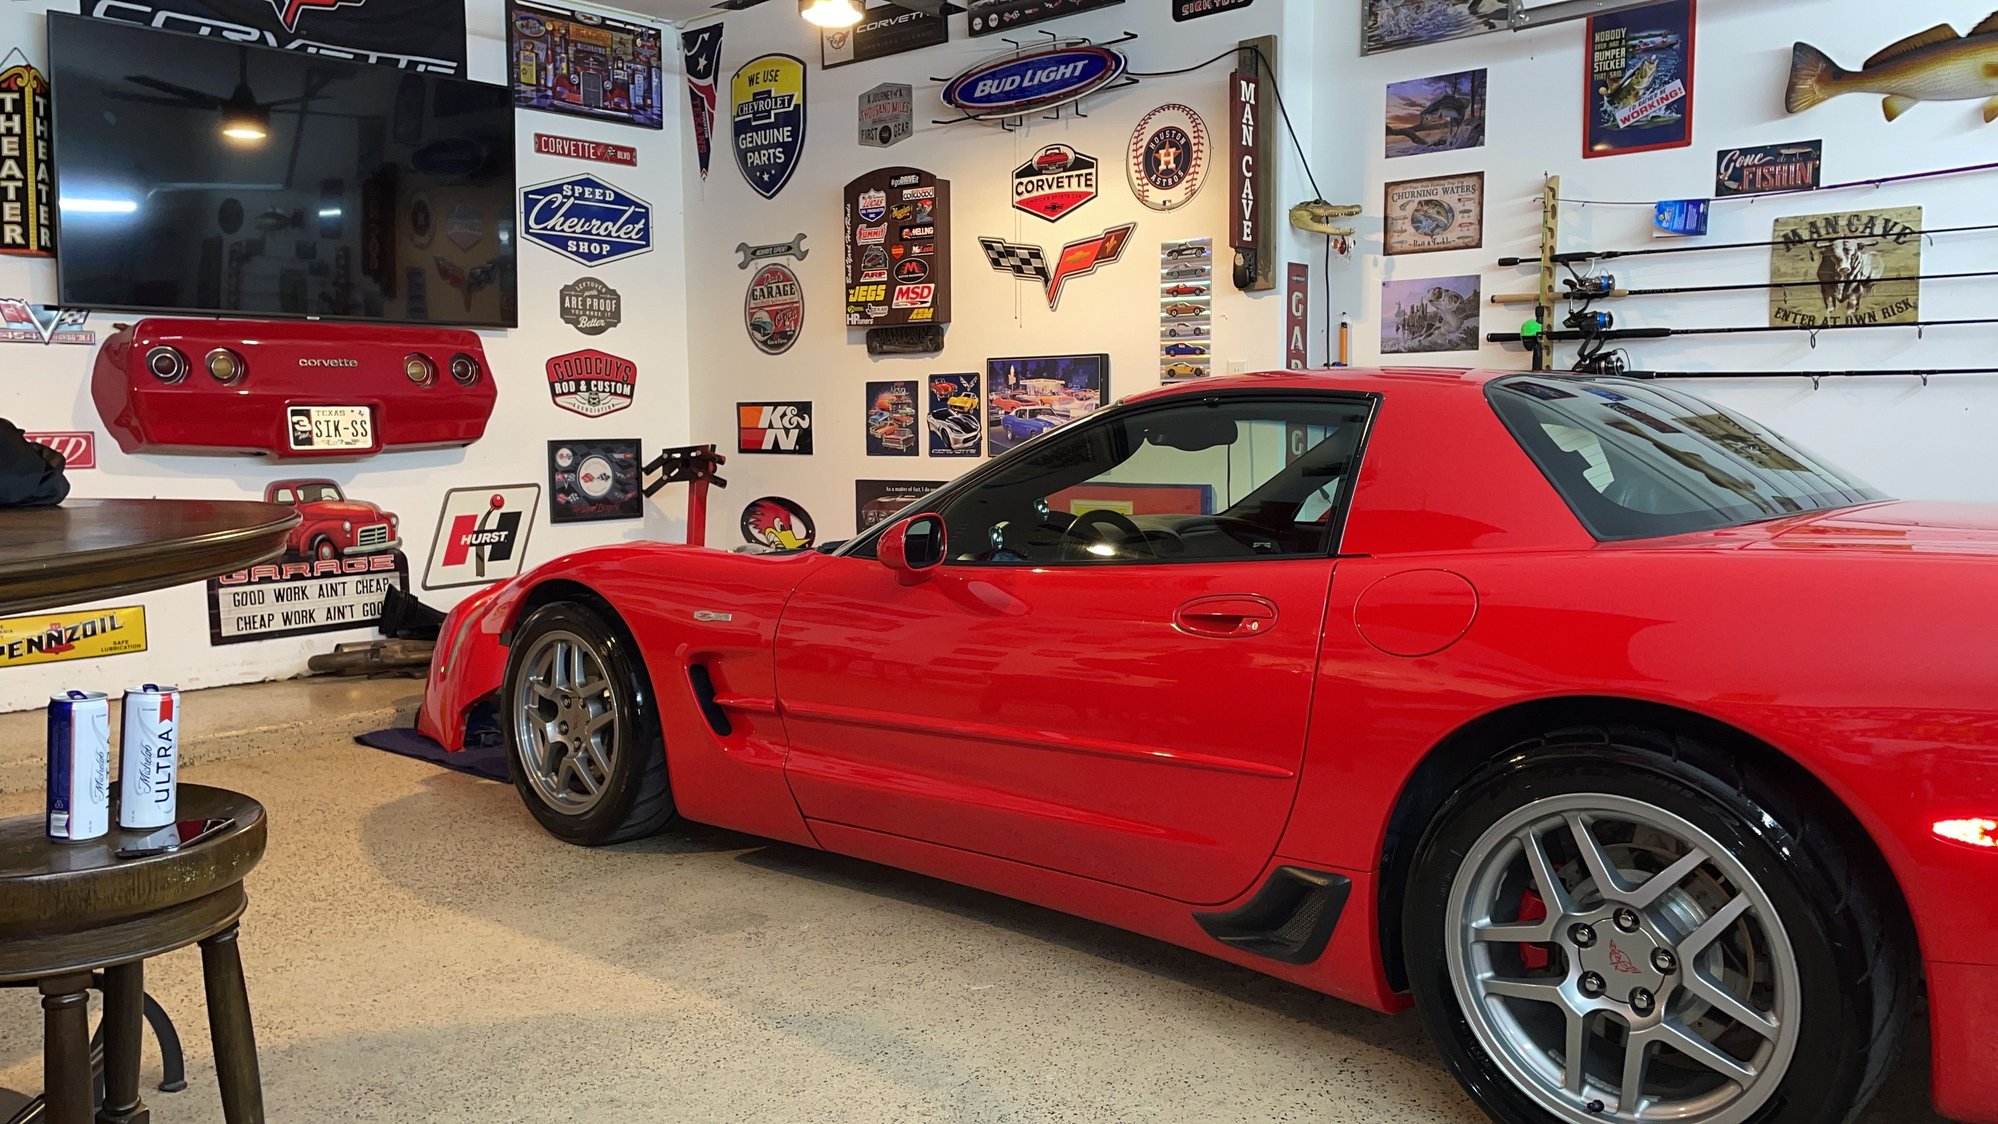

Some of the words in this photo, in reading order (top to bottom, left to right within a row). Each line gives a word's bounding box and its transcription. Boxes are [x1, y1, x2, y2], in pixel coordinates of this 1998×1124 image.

[857, 11, 929, 33] CORVETT
[1595, 27, 1626, 43] NOBODY
[1594, 48, 1625, 62] BUMPER
[1594, 59, 1625, 72] STICKER
[748, 72, 759, 87] WE
[763, 69, 779, 83] USE
[974, 76, 1020, 98] BUD
[1024, 60, 1088, 88] LIGHT
[738, 96, 790, 116] CHEVROLET
[1240, 80, 1255, 147] MAN
[1620, 86, 1683, 125] WORKING!
[738, 126, 792, 148] GENUINE
[1149, 130, 1186, 149] HOUSTON
[541, 136, 596, 158] CORVETTE
[617, 150, 630, 160] BLVD
[747, 148, 784, 167] PARTS
[0, 92, 24, 246] THEATER
[35, 96, 50, 248] THEATER
[1720, 150, 1773, 180] Gone
[1015, 172, 1092, 197] CORVETTE
[1150, 170, 1183, 186] ASTROS
[562, 184, 614, 201] SPEED
[1242, 156, 1252, 242] CAVE
[1392, 188, 1438, 202] CHURNING
[1442, 184, 1475, 195] WATERS
[528, 193, 645, 239] Chevrolet
[1782, 215, 1840, 253] MAN
[1846, 214, 1915, 245] CAVE
[568, 240, 610, 255] SHOP
[576, 281, 606, 293] LEFTOVER
[752, 283, 795, 301] GARAGE
[848, 284, 886, 302] JEGS
[896, 286, 931, 300] MSD
[564, 296, 582, 309] ARE
[586, 298, 616, 312] PROOF
[908, 308, 933, 319] AEM
[1774, 307, 1815, 326] ENTER
[1822, 316, 1840, 325] AT
[1846, 312, 1877, 326] OWN
[1882, 298, 1913, 319] RISK
[578, 316, 605, 328] Better
[298, 358, 358, 367] corvette
[553, 356, 631, 382] GOODGUYS
[554, 381, 575, 394] ROD
[580, 380, 586, 391] &
[590, 380, 631, 395] CUSTOM
[572, 402, 616, 413] ASSOCIATION
[314, 420, 367, 438] SIK-SS
[760, 428, 799, 450] N
[460, 530, 508, 546] HURST
[219, 554, 394, 585] GARAGE
[233, 590, 264, 607] GOOD
[274, 584, 309, 603] WORK
[318, 582, 347, 599] AIN'T
[356, 578, 389, 595] CHEAP
[236, 613, 274, 632] CHEAP
[282, 608, 315, 627] WORK
[326, 604, 354, 622] AIN'T
[362, 602, 383, 617] GOO
[100, 643, 141, 653] LUBRICATION
[138, 744, 152, 794] Michelob
[154, 728, 172, 803] ULTRA
[94, 750, 104, 802] Michelob
